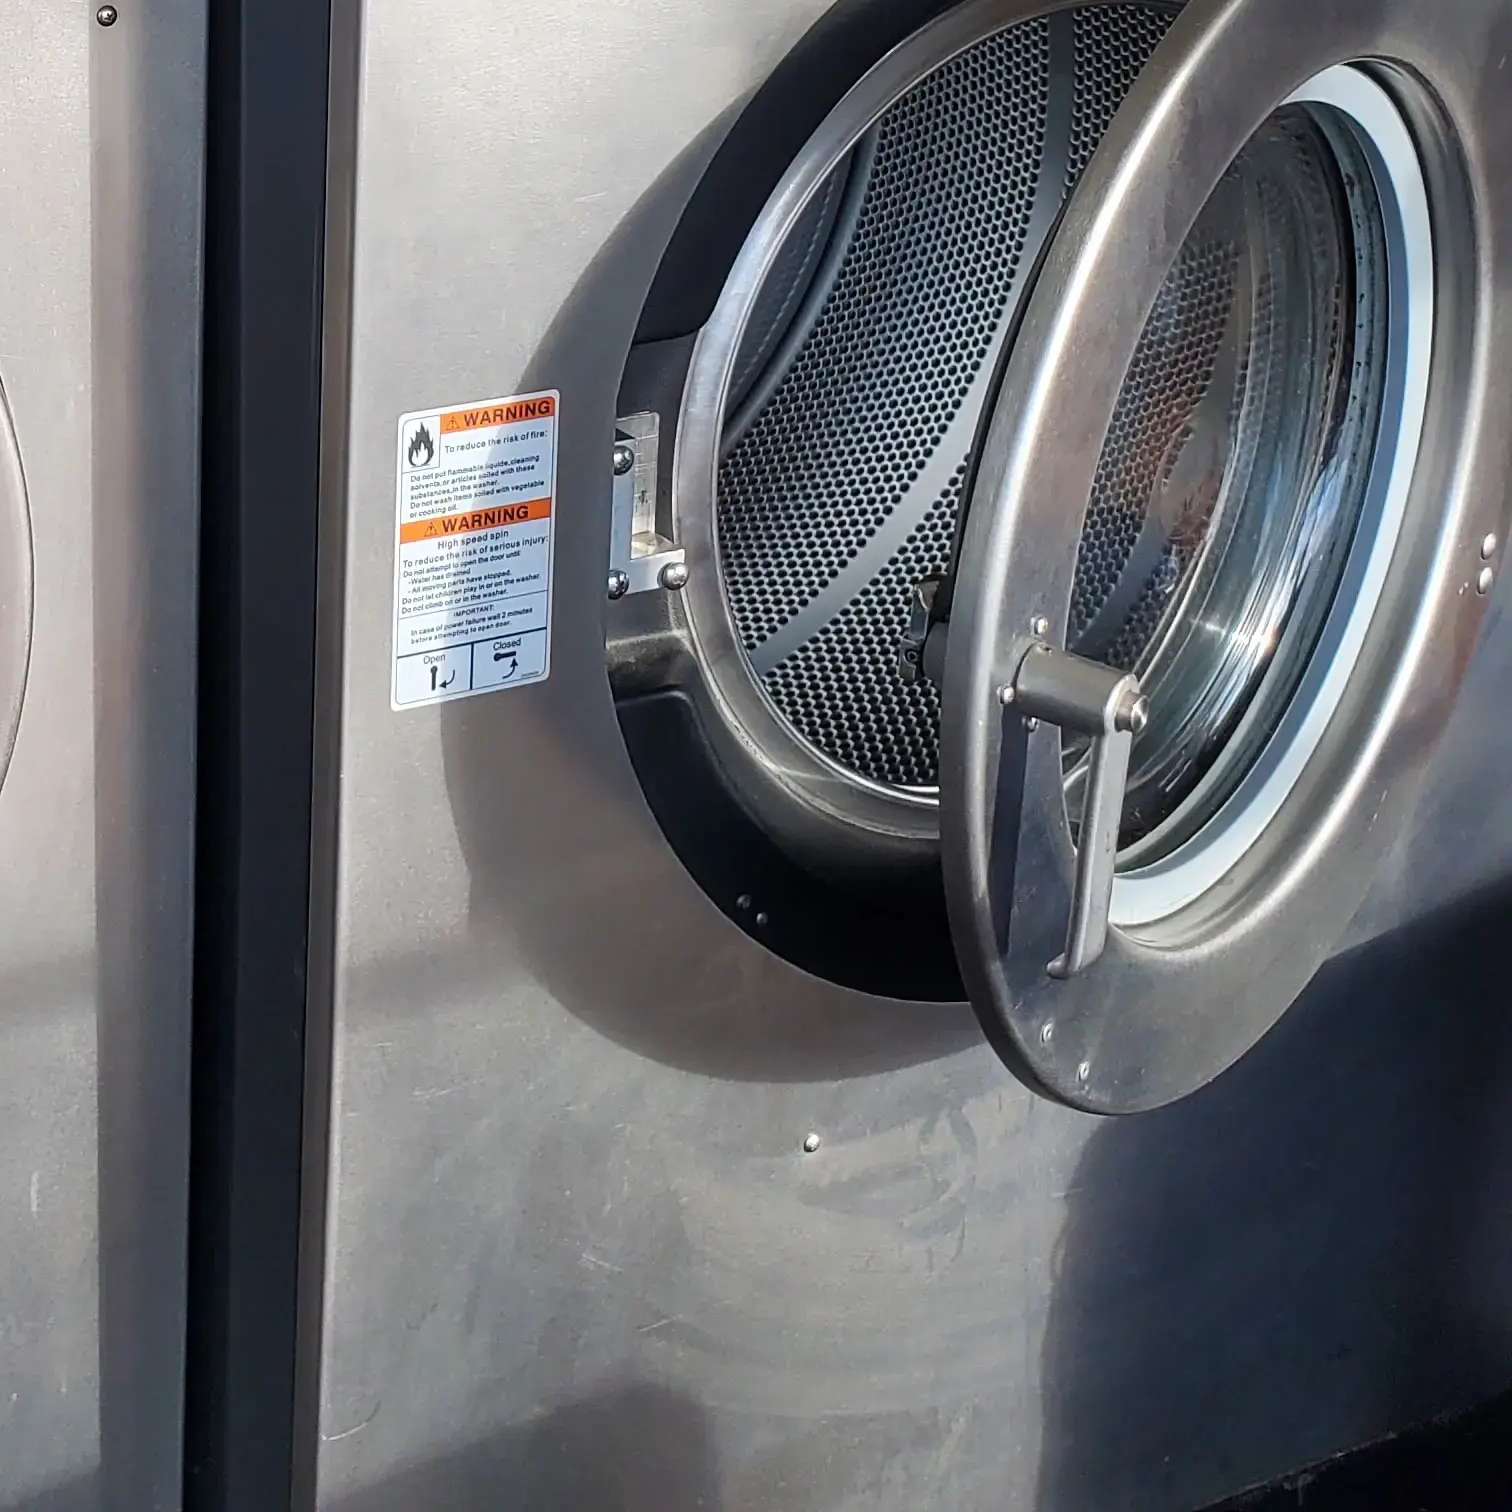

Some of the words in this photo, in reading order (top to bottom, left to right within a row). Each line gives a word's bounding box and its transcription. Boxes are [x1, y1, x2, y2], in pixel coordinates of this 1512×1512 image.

[464, 400, 550, 427] WARNING
[445, 445, 454, 453] To
[456, 441, 486, 452] reduce
[503, 435, 519, 443] risk
[531, 430, 547, 438] fire:
[496, 486, 510, 495] with
[442, 506, 529, 532] WARNING
[438, 539, 458, 550] High
[461, 535, 488, 546] speed
[490, 530, 509, 542] spin
[403, 560, 412, 568] To
[415, 555, 444, 566] reduce
[462, 549, 477, 557] risk
[490, 541, 520, 552] serious
[522, 535, 548, 548] injury:
[454, 605, 495, 618] IMPORTANT:
[493, 638, 521, 651] Closed
[423, 654, 446, 665] Open
